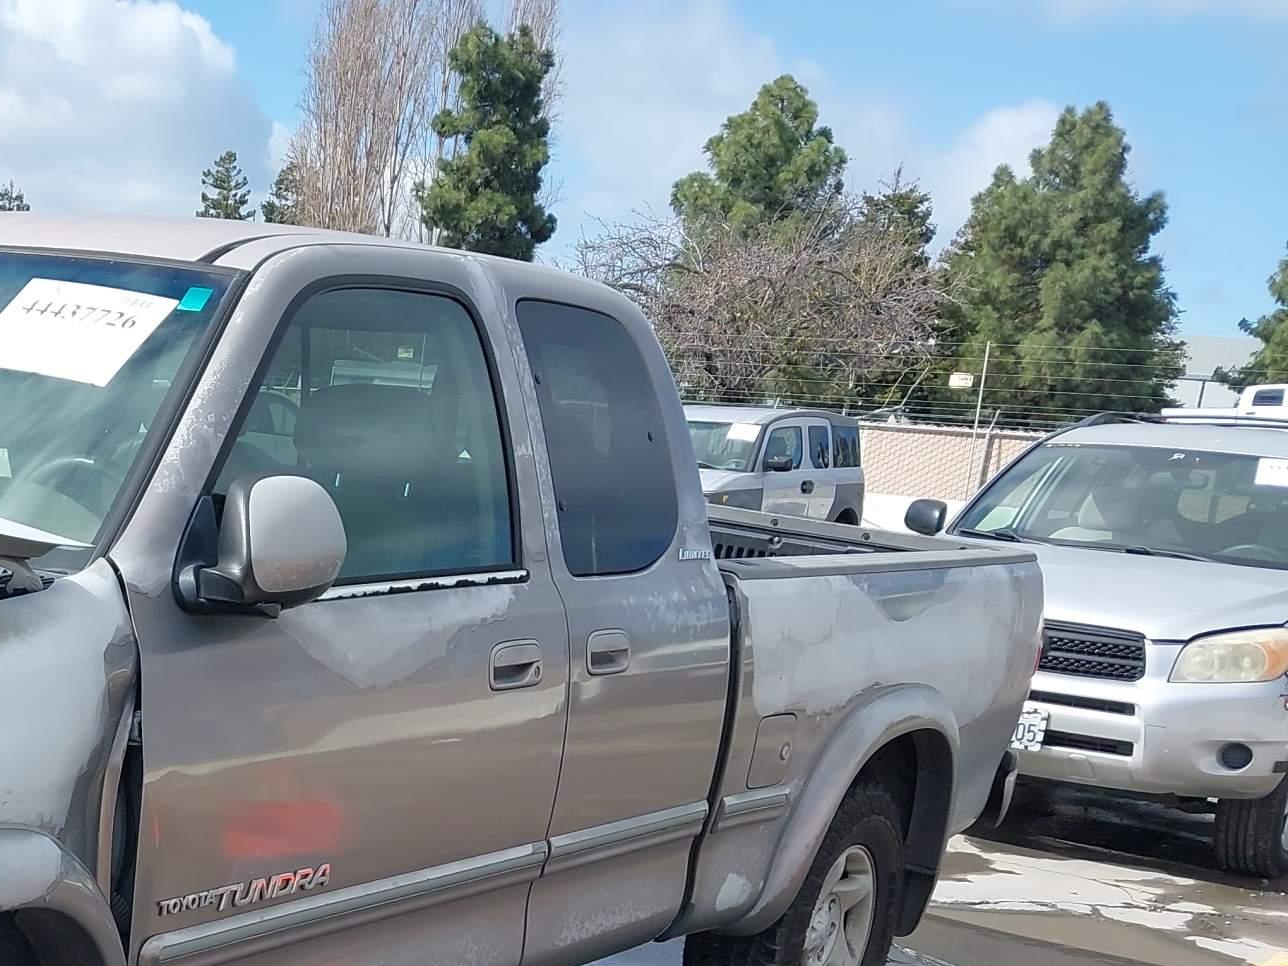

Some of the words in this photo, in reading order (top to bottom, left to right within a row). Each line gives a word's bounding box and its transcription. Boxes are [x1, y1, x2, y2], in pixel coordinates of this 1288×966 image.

[23, 300, 136, 329] 44437726
[158, 890, 215, 916] TOYOTA
[215, 863, 331, 912] TUNDRA
